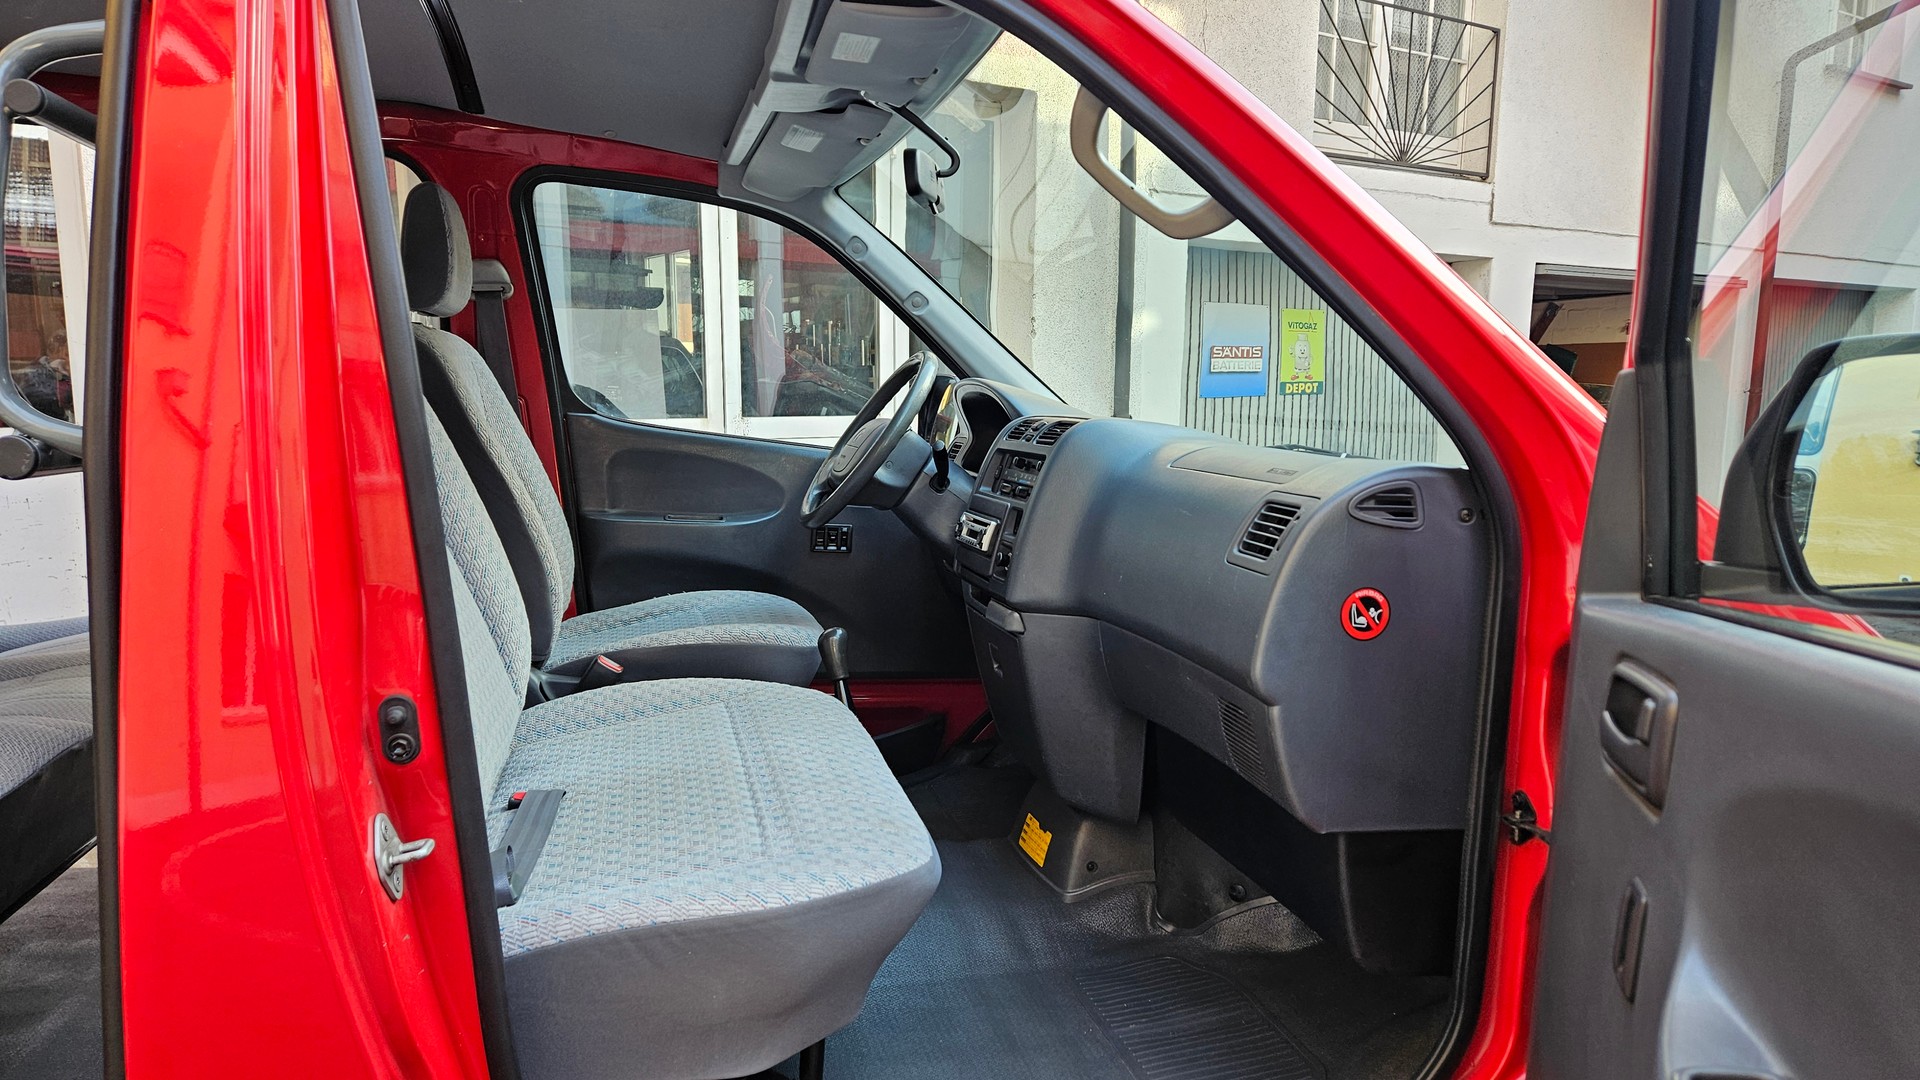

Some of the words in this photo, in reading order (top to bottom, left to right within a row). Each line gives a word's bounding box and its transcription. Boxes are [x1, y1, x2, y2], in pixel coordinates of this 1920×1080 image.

[1212, 346, 1262, 358] SÄNTIS
[1212, 360, 1261, 370] BATTERIE
[1285, 382, 1319, 394] DEPOT
